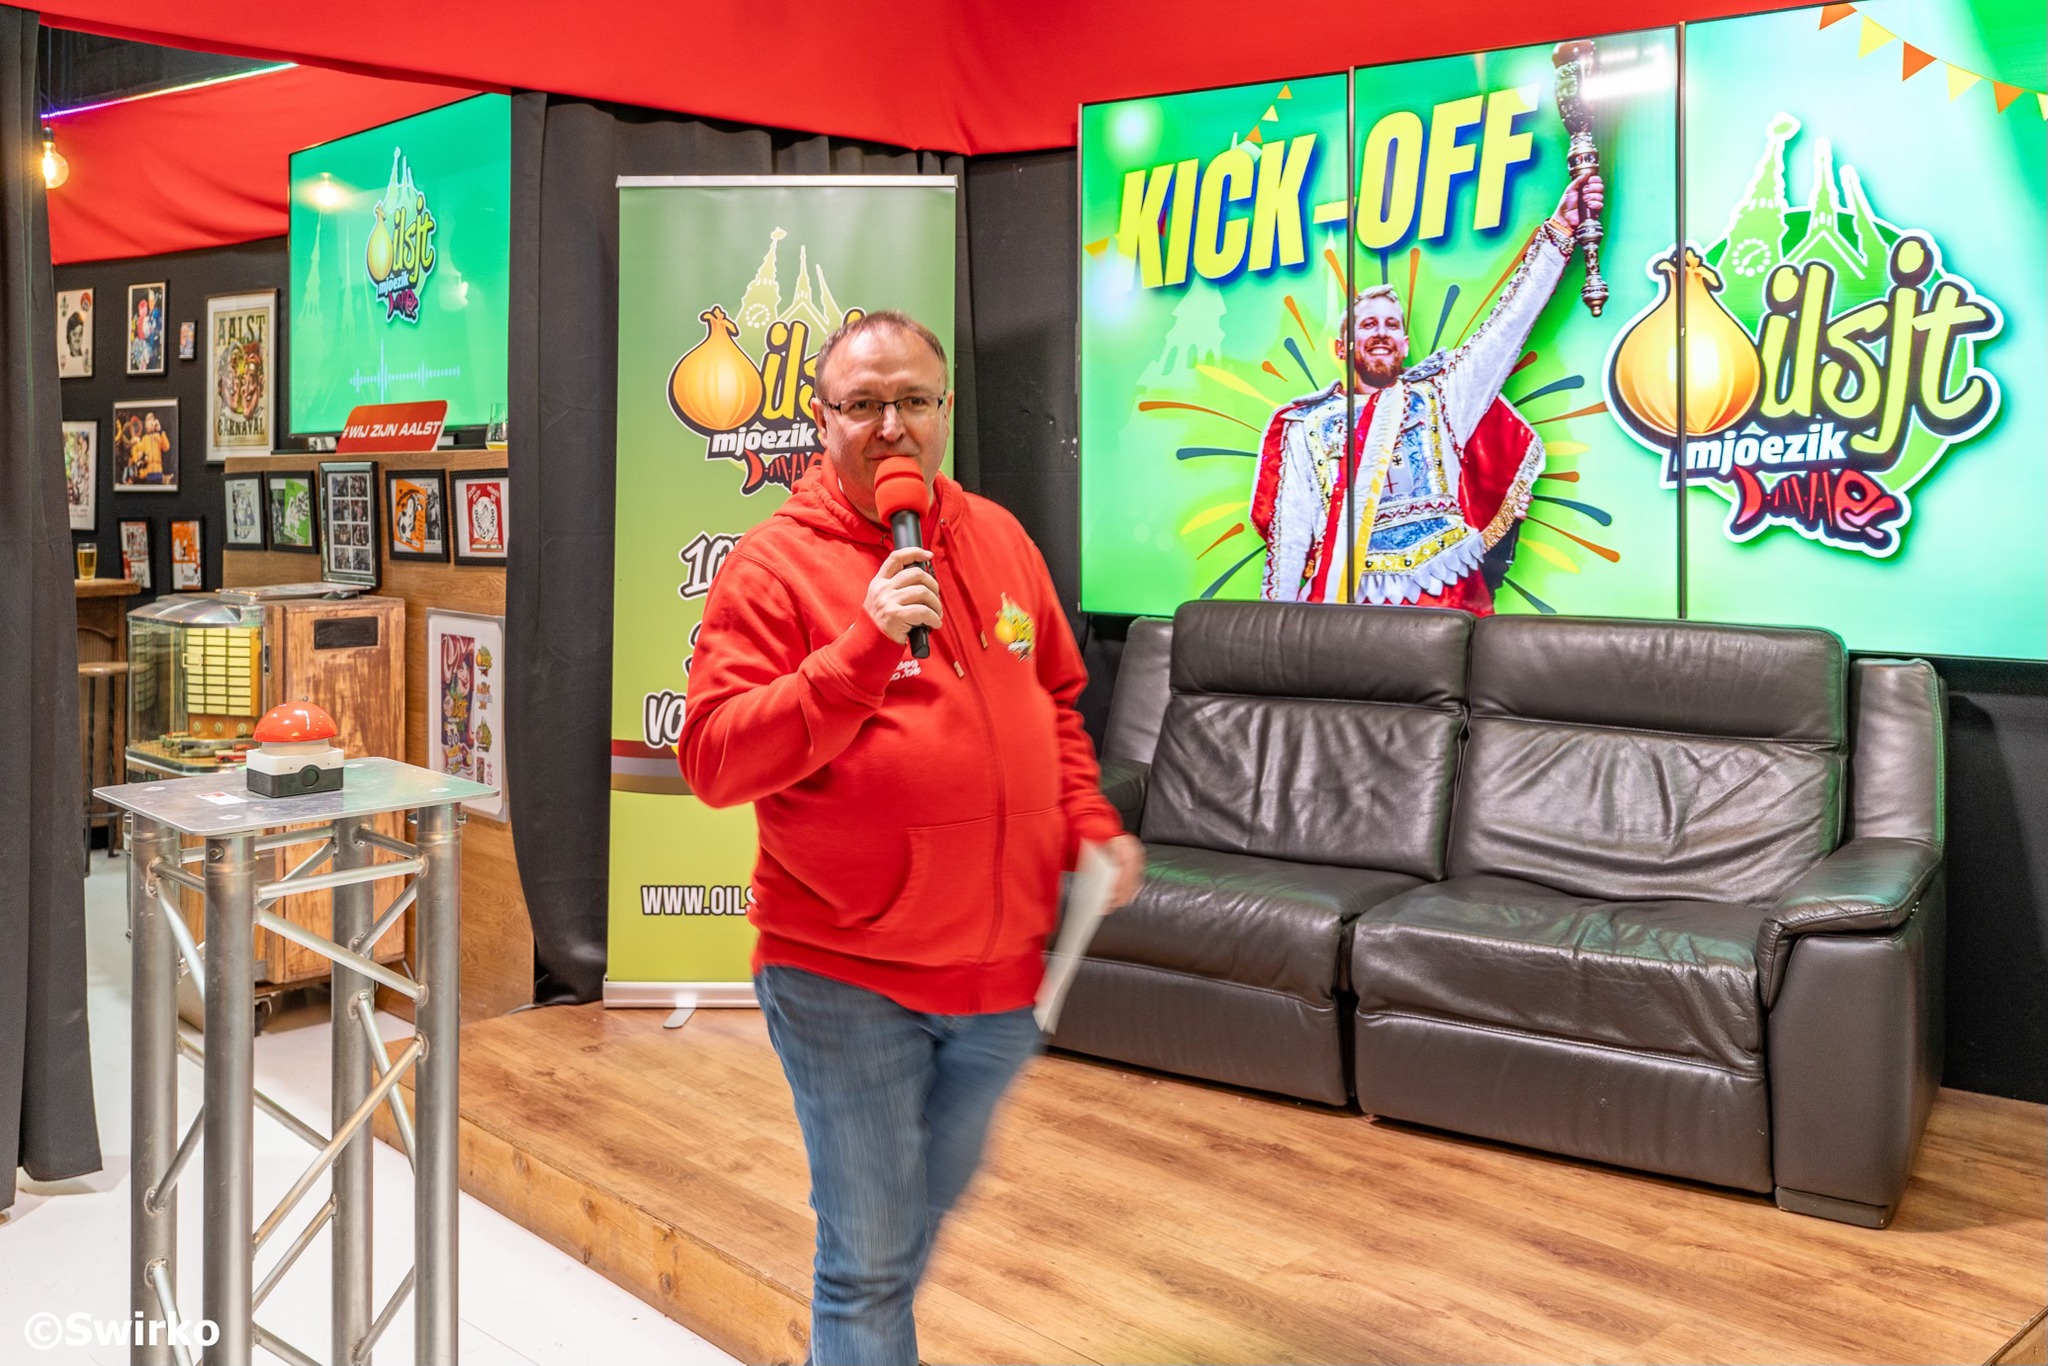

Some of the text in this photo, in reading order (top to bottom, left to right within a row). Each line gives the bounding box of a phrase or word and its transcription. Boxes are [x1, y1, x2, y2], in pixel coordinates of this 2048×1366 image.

[1117, 84, 1541, 290] KICK-OFF
[217, 314, 266, 347] AALST
[217, 416, 265, 437] CARNAVAL
[369, 422, 399, 438] ZIJN
[398, 420, 442, 436] AALST
